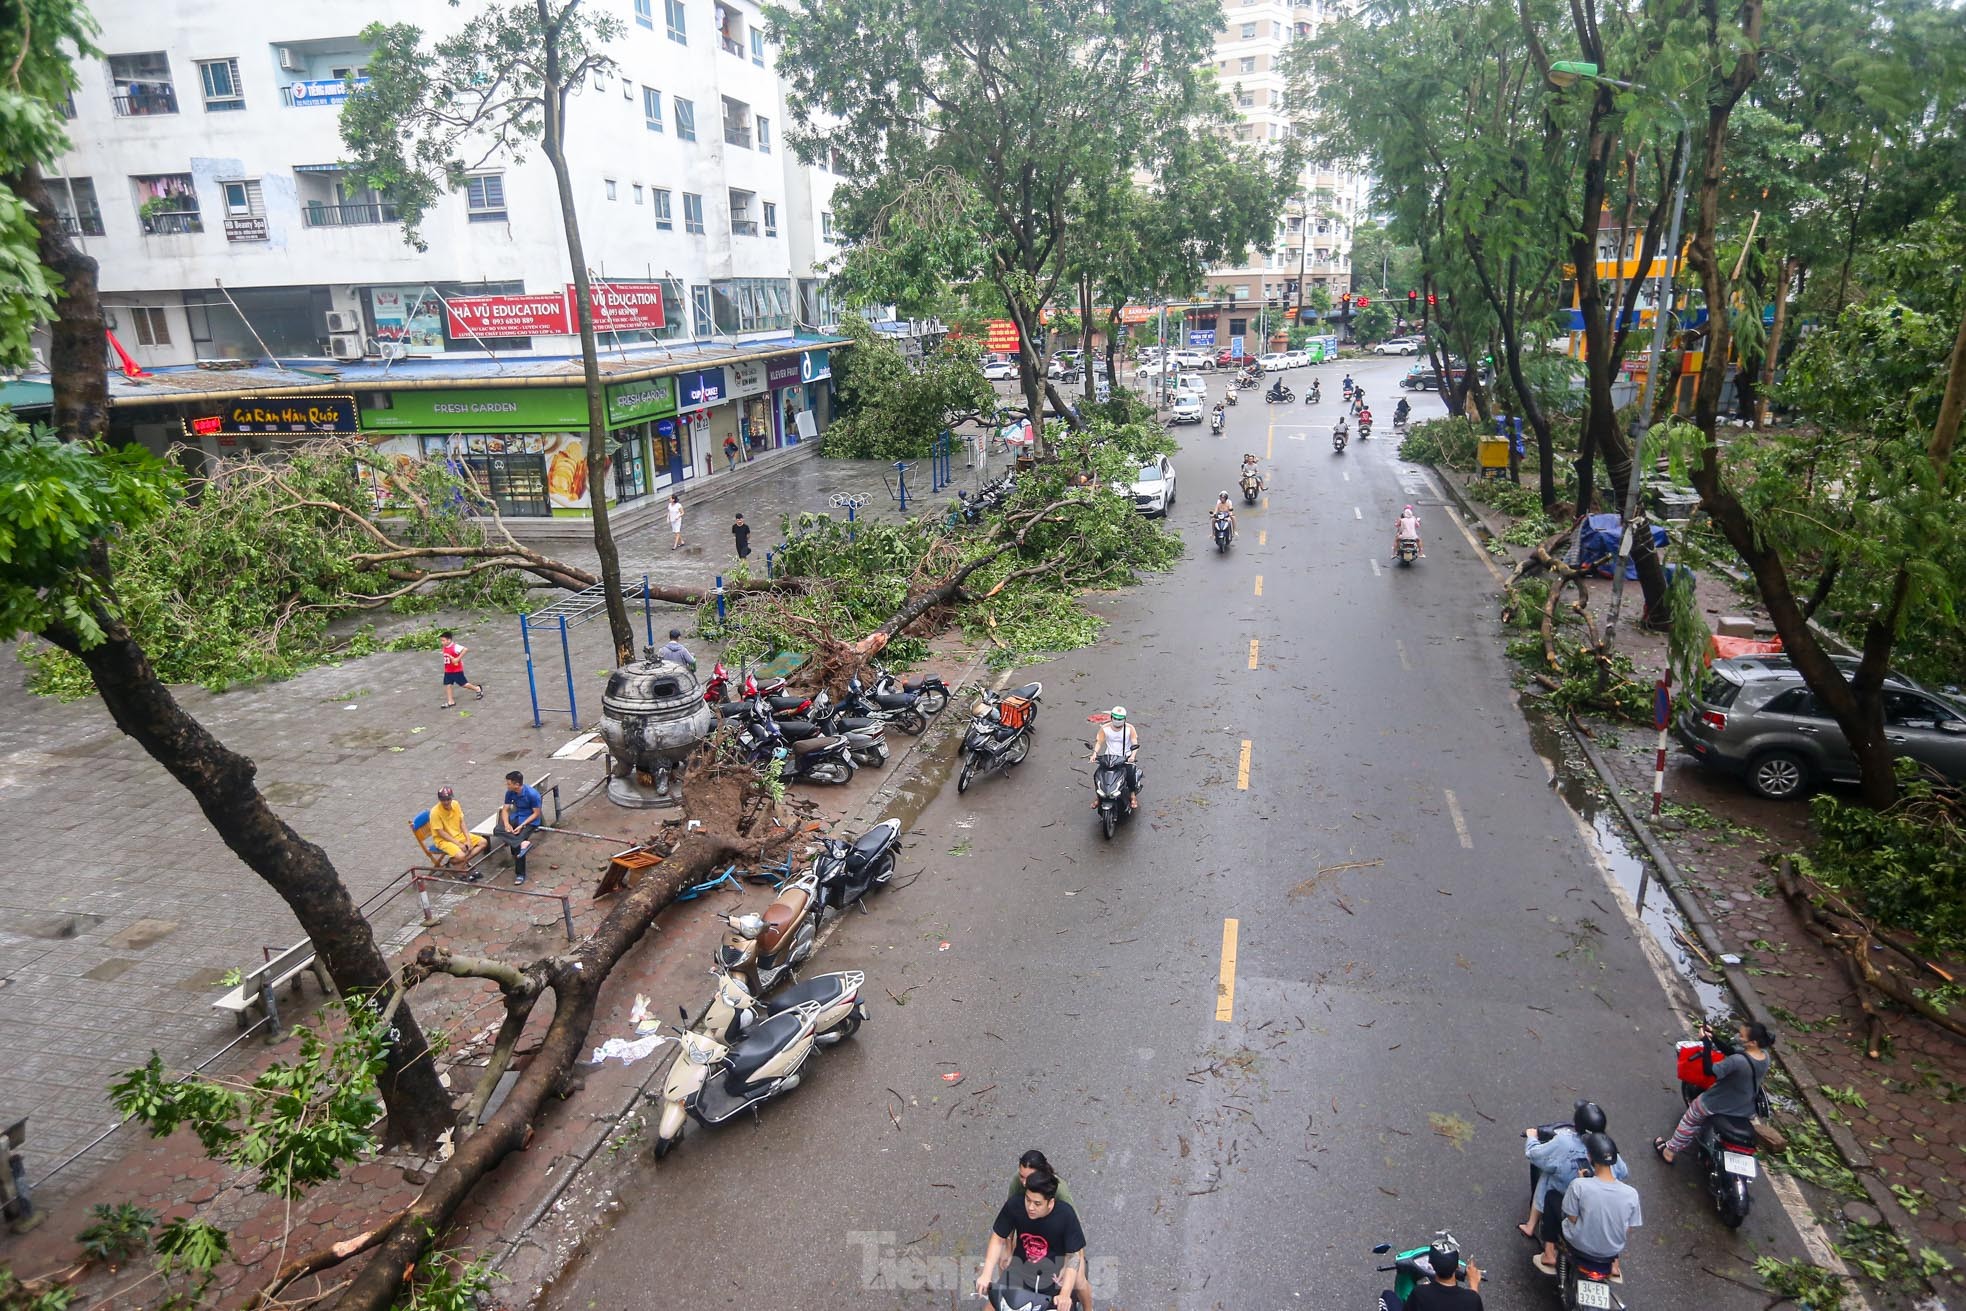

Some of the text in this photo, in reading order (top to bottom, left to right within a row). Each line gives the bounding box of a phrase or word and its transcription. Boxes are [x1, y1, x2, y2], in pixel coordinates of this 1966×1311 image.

[608, 294, 656, 305] EDUCATION
[1358, 297, 1369, 307] 23
[474, 304, 489, 317] VŨ
[494, 304, 559, 316] EDUCATION
[787, 367, 799, 376] FRUIT
[617, 386, 668, 407] FRESH GARDEN
[433, 402, 516, 413] FRESH GARDEN
[1583, 1282, 1604, 1296] 34-E1
